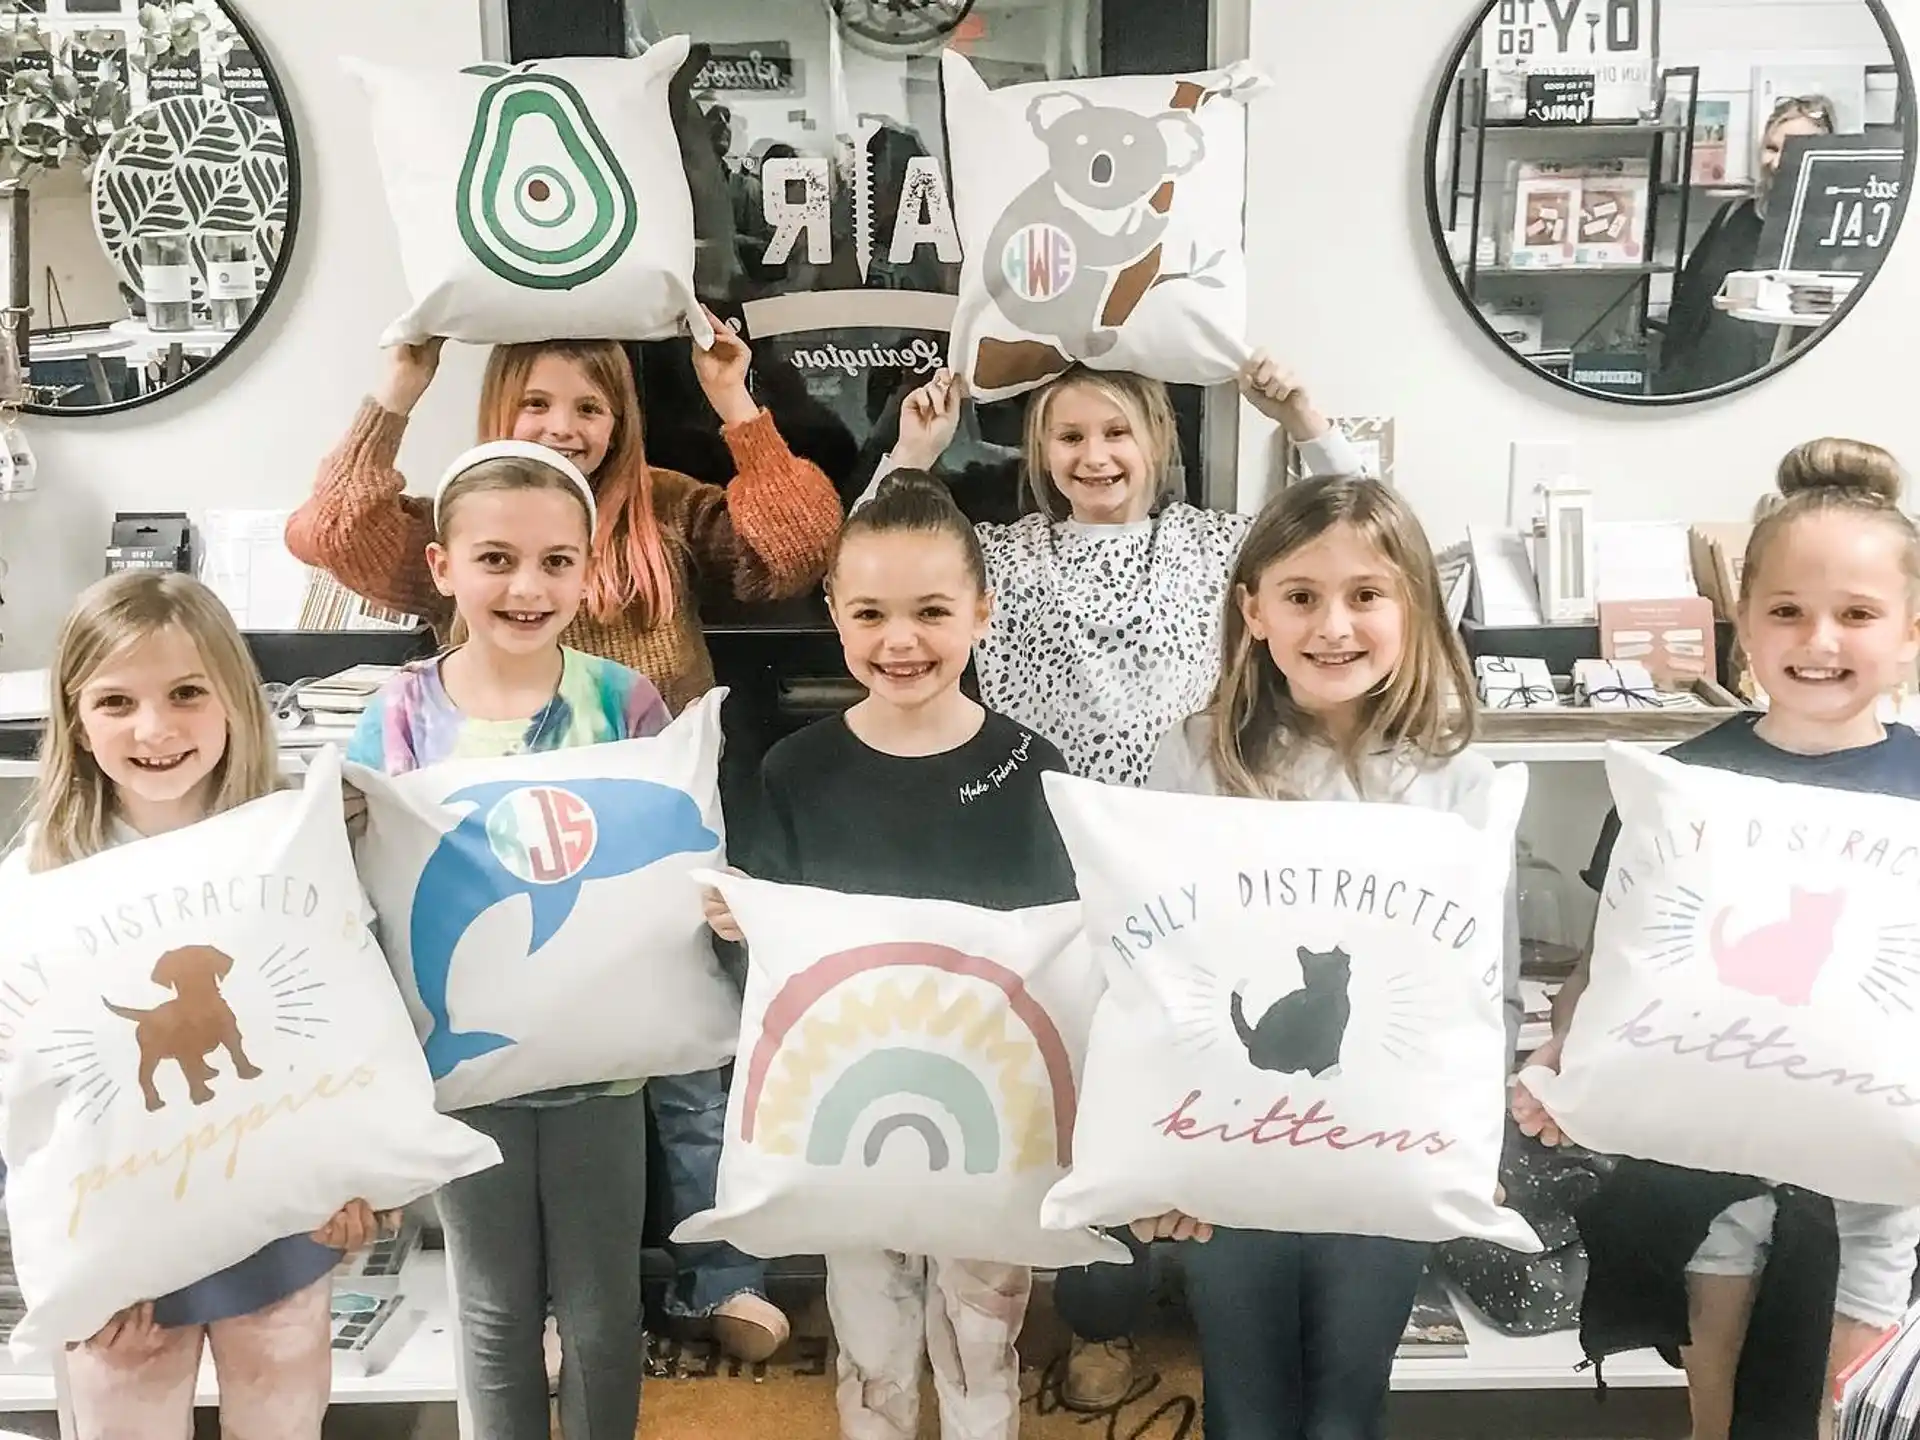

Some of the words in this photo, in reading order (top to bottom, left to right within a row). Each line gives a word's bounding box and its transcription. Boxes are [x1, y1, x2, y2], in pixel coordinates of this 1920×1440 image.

[958, 779, 990, 805] Make
[986, 758, 1019, 789] Today
[74, 873, 320, 957] DISTRACTED
[1110, 881, 1199, 971] ASILY
[1236, 866, 1478, 950] DISTRACTED
[1606, 997, 1920, 1107] kittens
[67, 1061, 377, 1239] puppies
[1151, 1088, 1459, 1155] kittens
